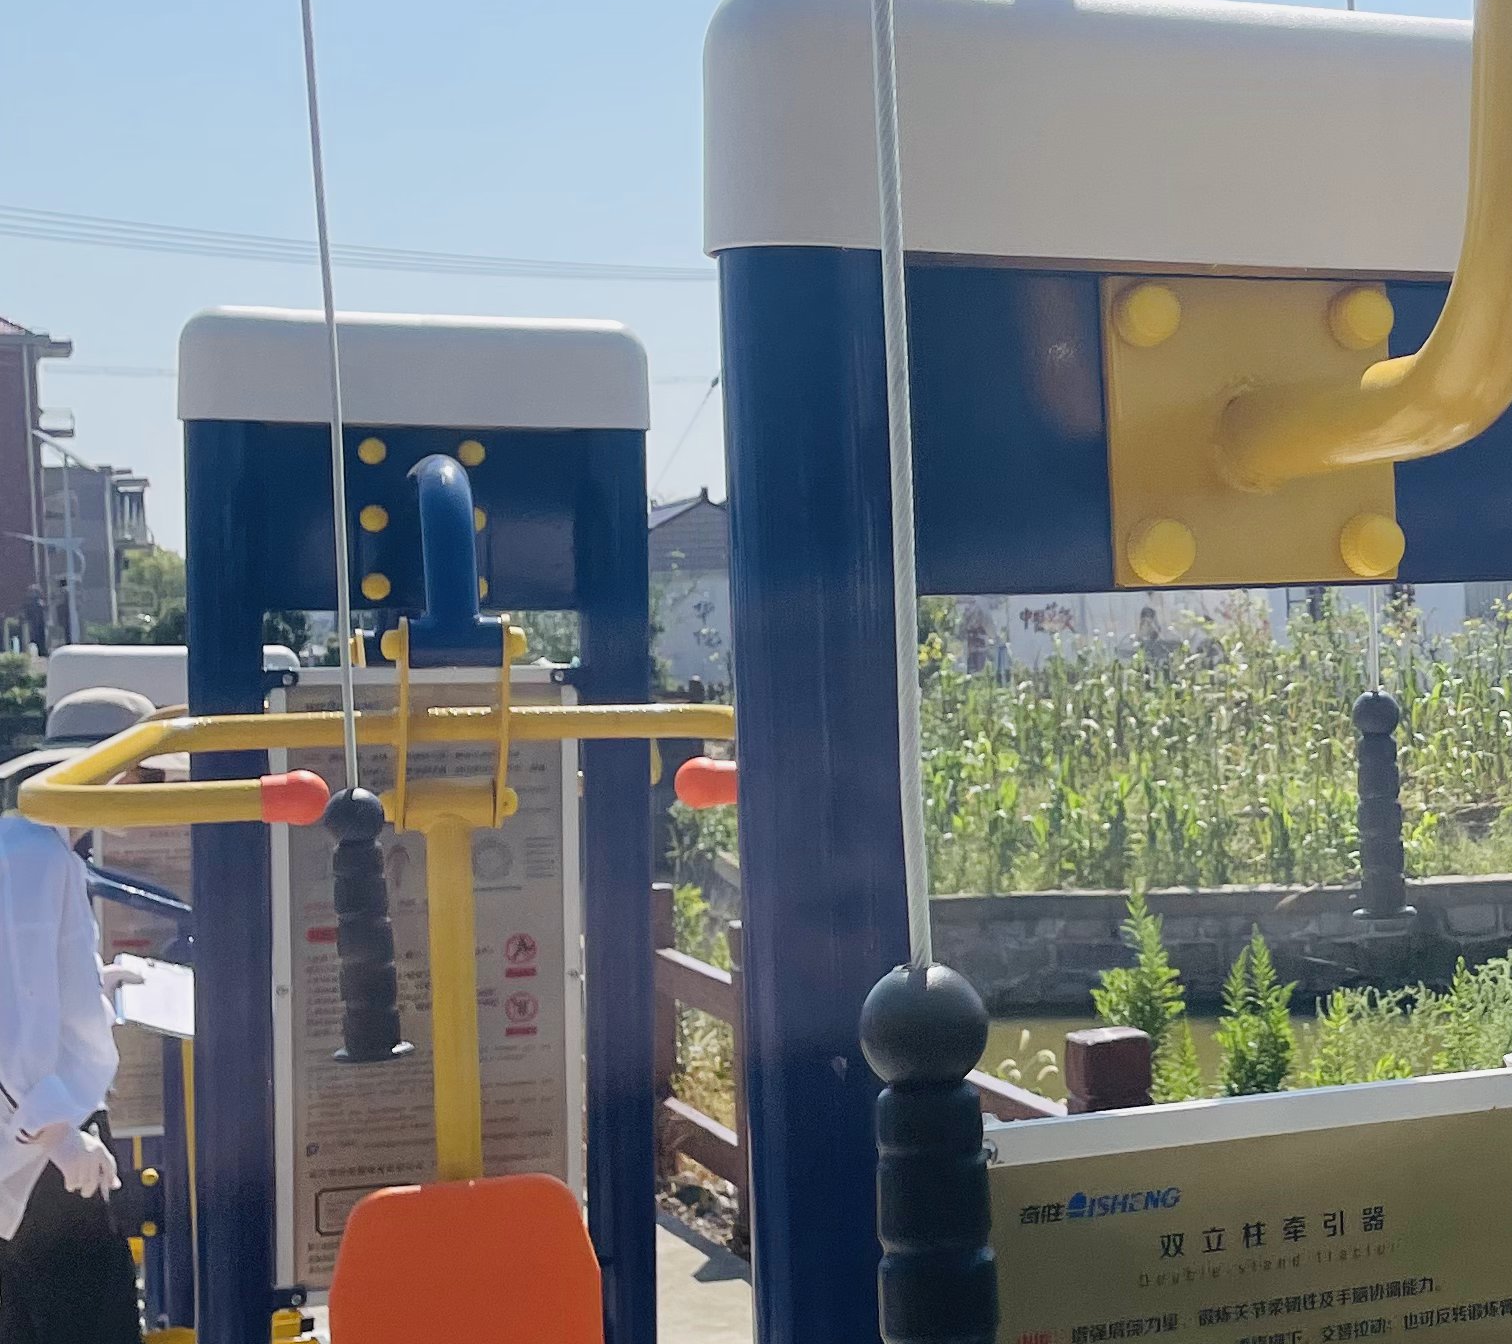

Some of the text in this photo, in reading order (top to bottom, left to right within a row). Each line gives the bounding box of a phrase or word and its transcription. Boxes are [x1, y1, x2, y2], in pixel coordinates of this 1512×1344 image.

[1159, 1205, 1385, 1258] 双立柱牵引器
